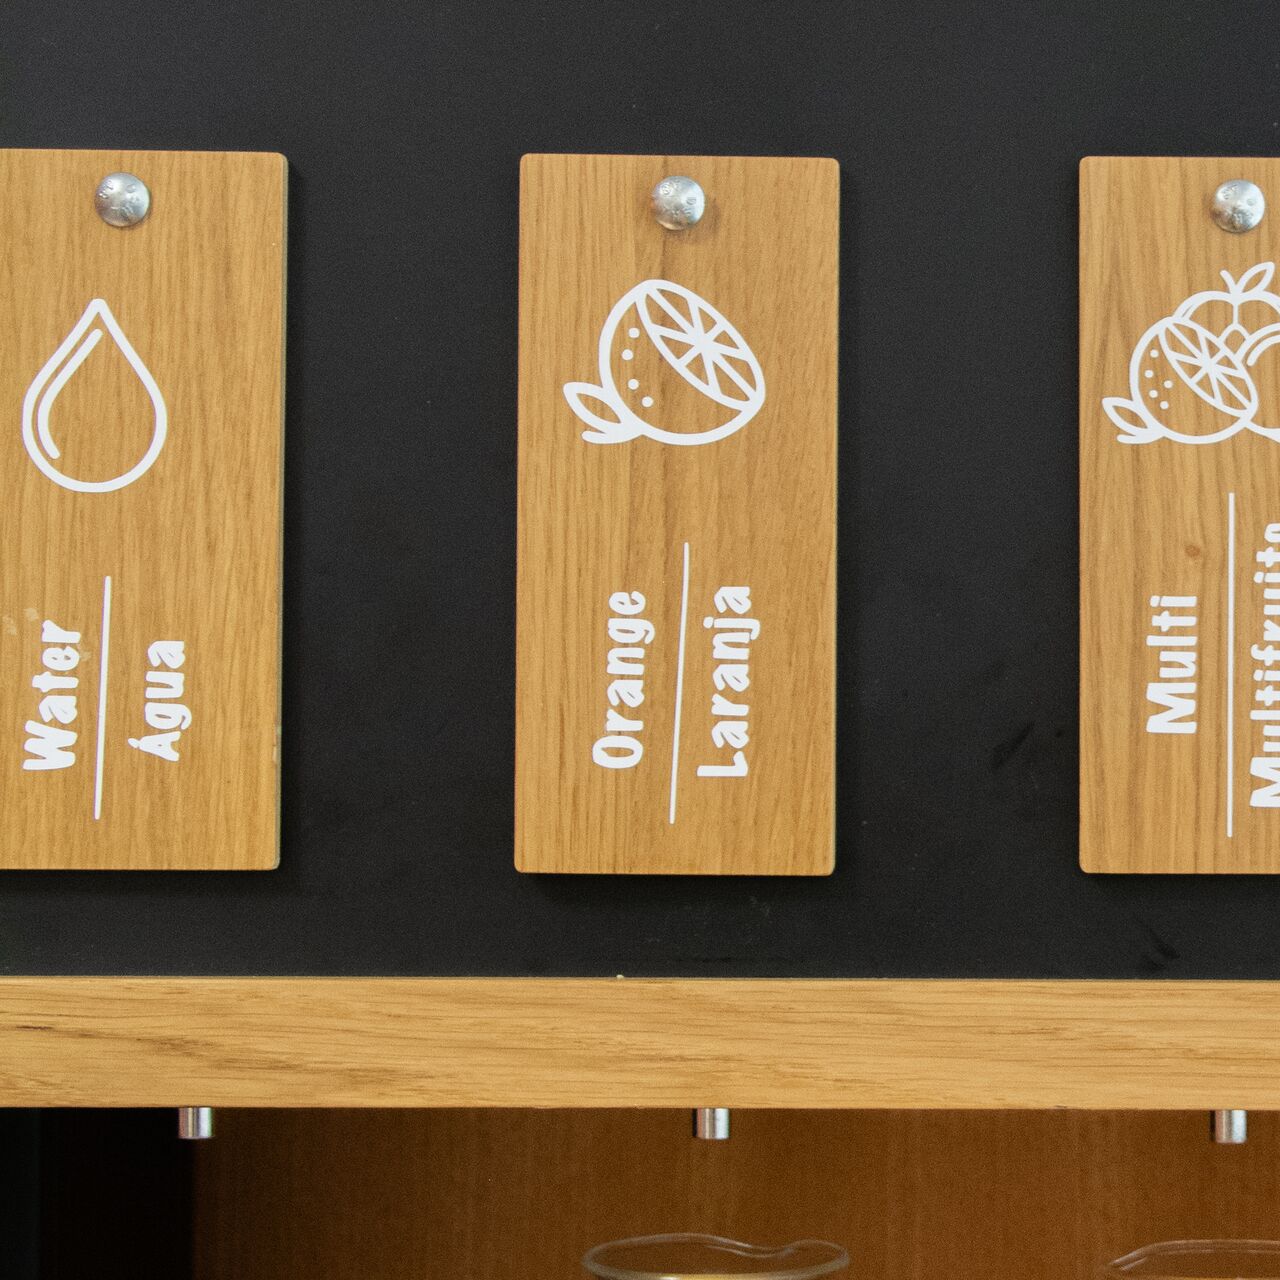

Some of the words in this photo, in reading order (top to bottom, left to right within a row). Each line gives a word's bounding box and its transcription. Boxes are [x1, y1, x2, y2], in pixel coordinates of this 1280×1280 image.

[22, 619, 81, 772] Water
[127, 640, 193, 762] Água
[591, 591, 656, 770] Orange
[696, 585, 761, 778] Laranja
[1145, 594, 1198, 735] Multi
